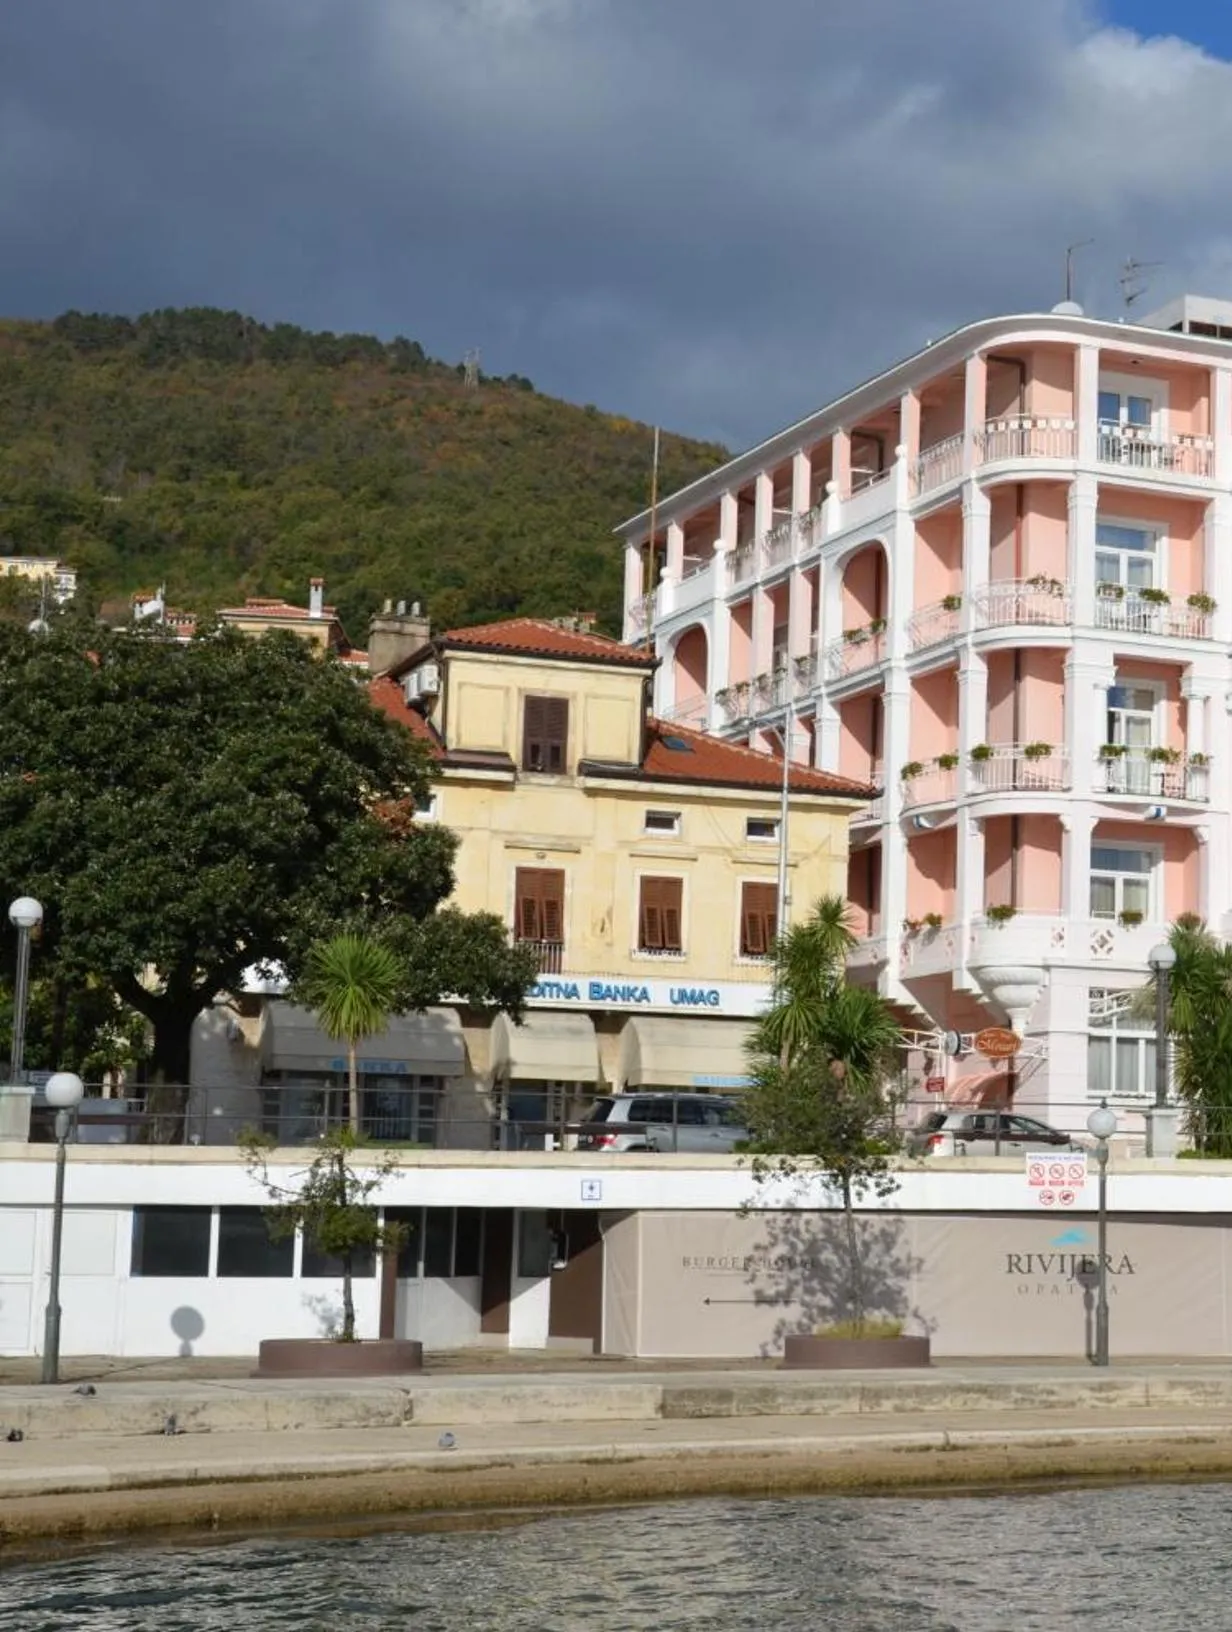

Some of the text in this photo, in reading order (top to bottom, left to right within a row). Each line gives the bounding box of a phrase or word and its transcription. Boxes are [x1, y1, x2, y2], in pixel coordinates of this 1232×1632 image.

[588, 981, 651, 1003] BANKA
[669, 987, 720, 1006] UMAG
[1006, 1253, 1136, 1282] RIVIJERA
[1016, 1283, 1119, 1296] OPATA
